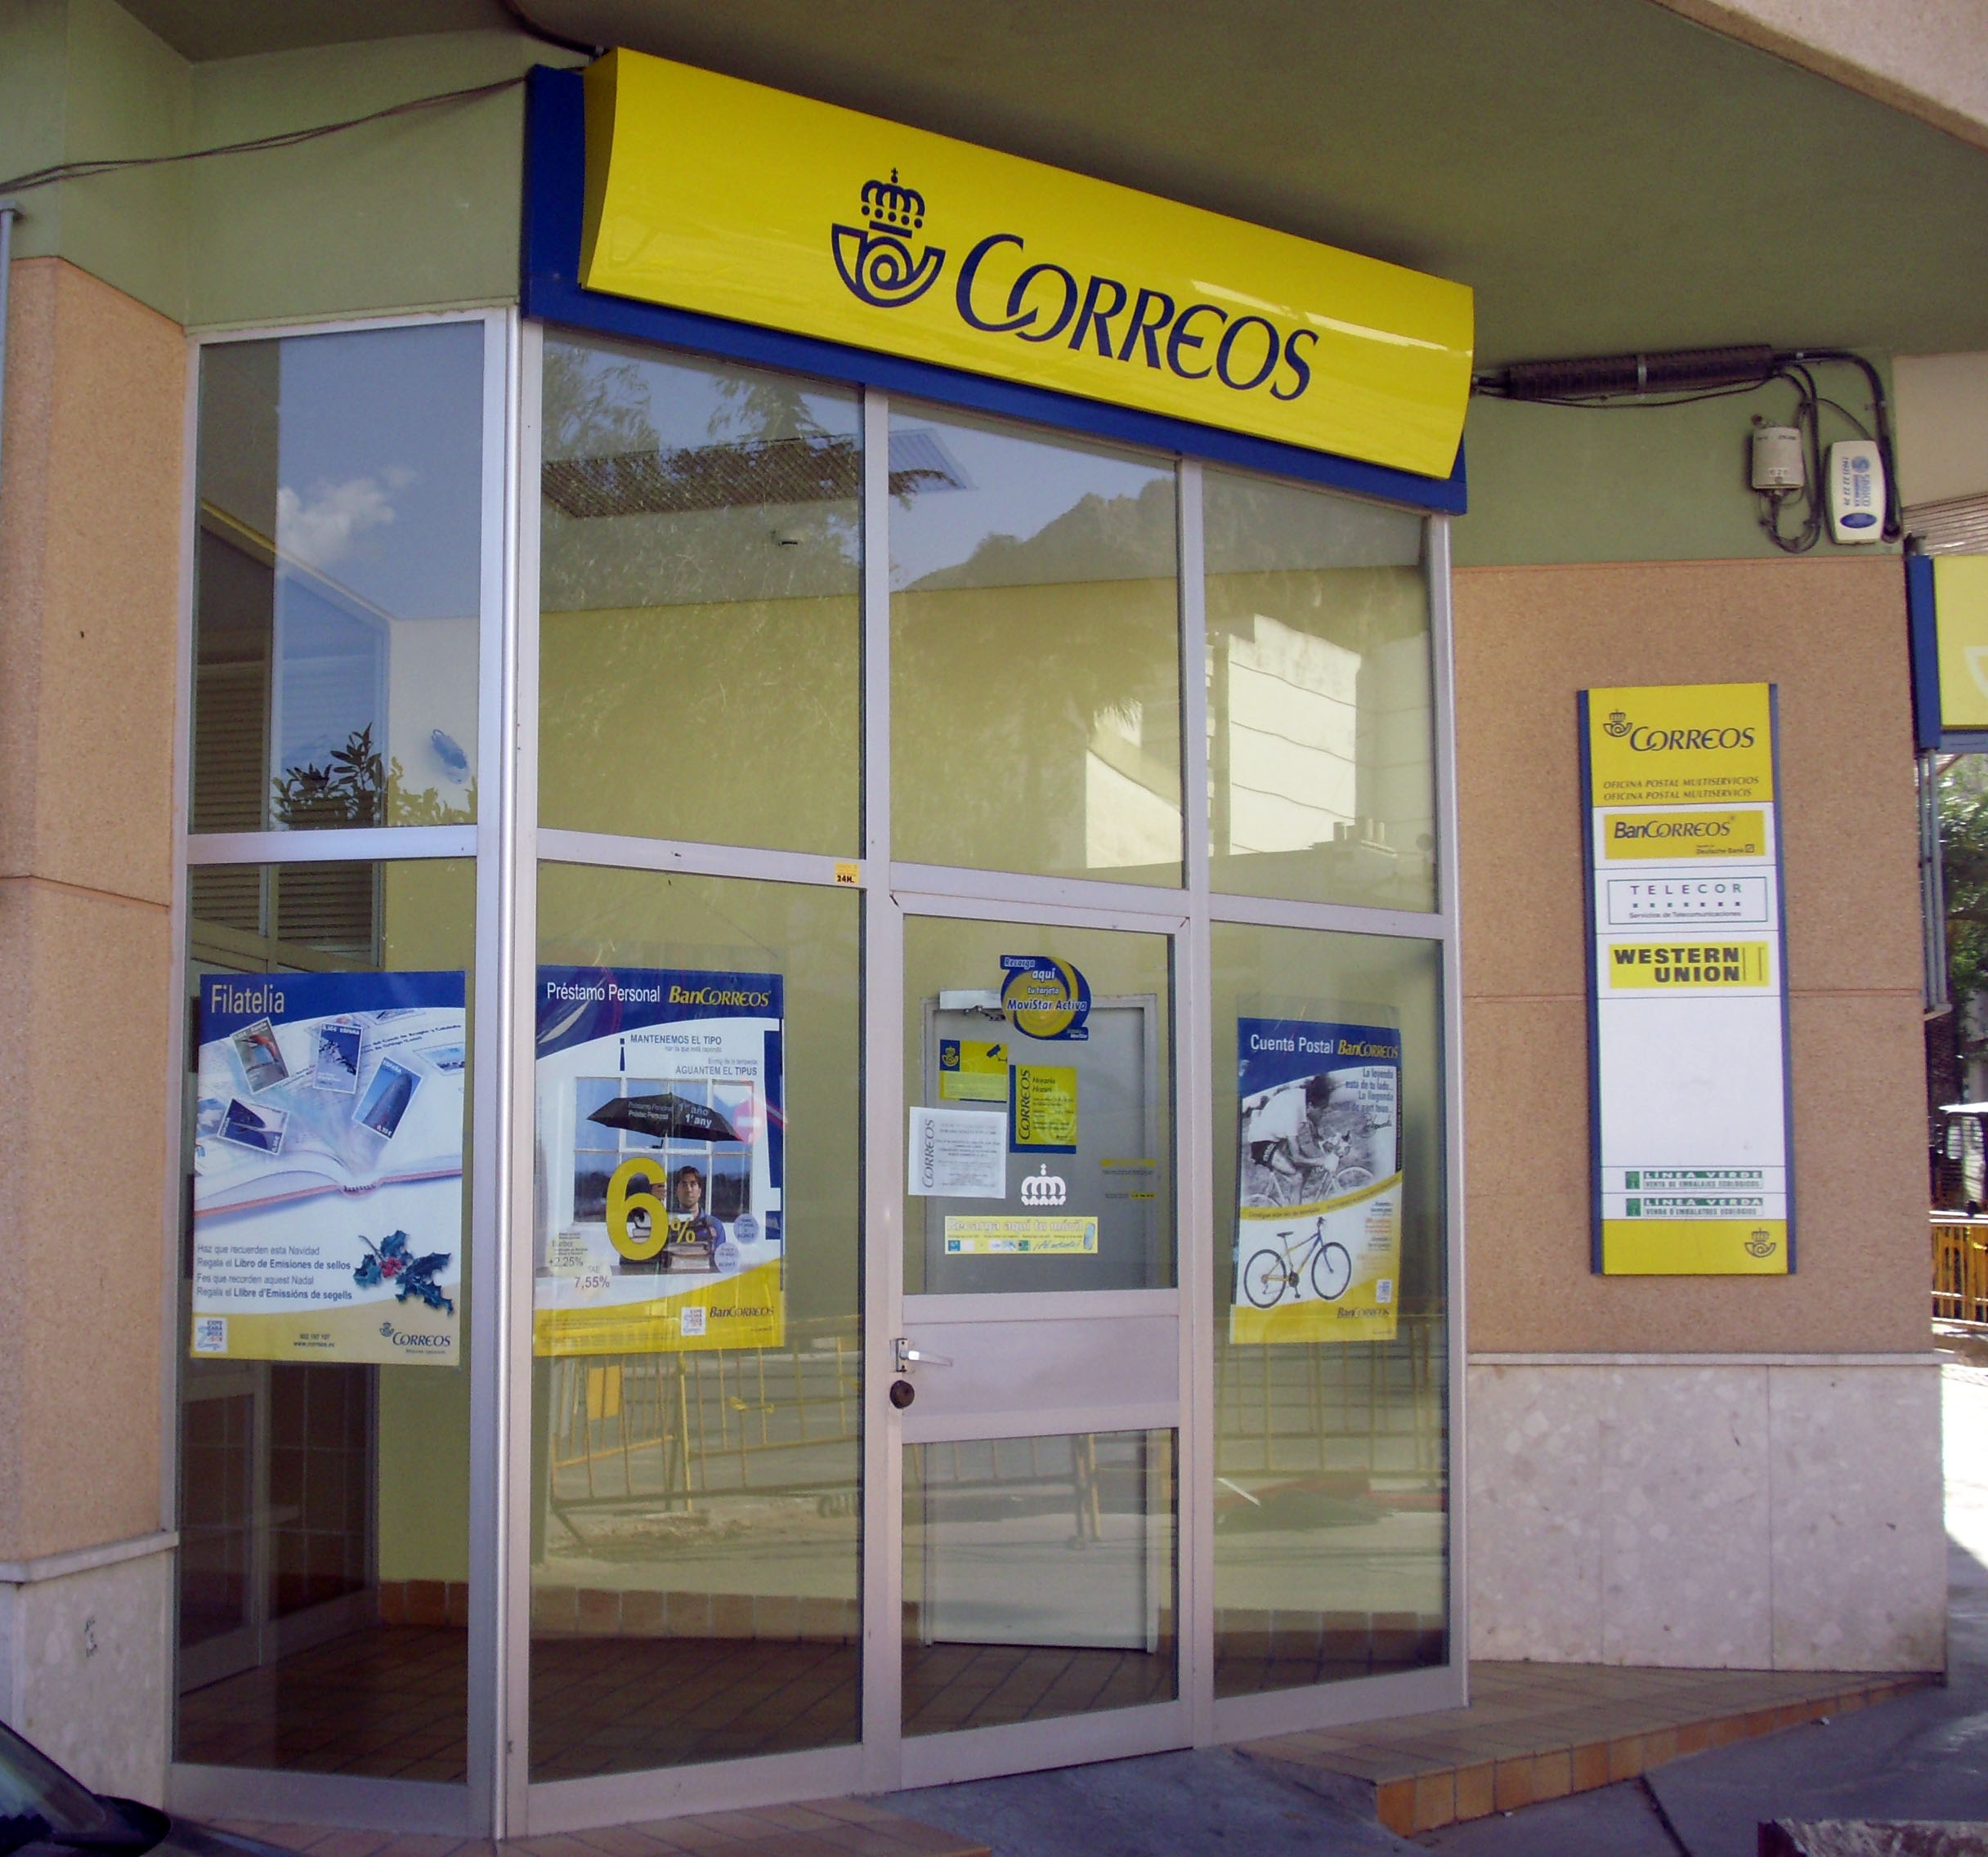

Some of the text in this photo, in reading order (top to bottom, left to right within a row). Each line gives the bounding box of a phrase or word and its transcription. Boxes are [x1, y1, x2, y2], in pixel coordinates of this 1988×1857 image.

[956, 233, 1319, 400] CORREOS
[1629, 726, 1755, 752] CORREOS
[1604, 776, 1759, 789] OFICINA POSTAL MULTISERVICIOS
[1604, 789, 1752, 800] OFICINA POSTAL MULTISERVICIS
[1630, 884, 1741, 895] TELECOR
[1614, 947, 1740, 964] WESTERN
[1004, 957, 1035, 969] Recarga
[1032, 968, 1056, 982] aquí
[1654, 966, 1740, 982] UNION
[547, 982, 605, 1001] Préstamo
[609, 984, 660, 1002] Personal
[1037, 987, 1059, 996] tarjeta
[211, 983, 284, 1014] Filatelia
[1007, 999, 1087, 1011] MoviStar Activa
[630, 1035, 721, 1045] MANTENEMOS EL TIPO
[1251, 1034, 1294, 1052] Cuenta
[1298, 1036, 1333, 1054] Postal
[675, 1066, 757, 1076] AGUANTEM EL TIPUS
[1019, 1069, 1031, 1139] CORREOS
[694, 1116, 712, 1128] any
[922, 1119, 935, 1188] CORREOS
[1004, 1219, 1030, 1233] aquí
[214, 1247, 228, 1256] que
[231, 1246, 269, 1255] recuerden
[289, 1246, 320, 1255] Navidad
[197, 1258, 224, 1267] Regala
[235, 1259, 255, 1267] Libro
[257, 1260, 267, 1268] de
[270, 1260, 311, 1269] Emisiones
[314, 1260, 324, 1269] de
[326, 1260, 351, 1270] sellos
[197, 1273, 314, 1285] Fes que recorden aquest Nadal
[575, 1276, 610, 1288] 7,55%
[197, 1287, 223, 1297] Regala
[234, 1287, 256, 1296] Llibre
[311, 1289, 321, 1298] de
[323, 1290, 351, 1301] segells
[392, 1331, 450, 1346] CORREOS
